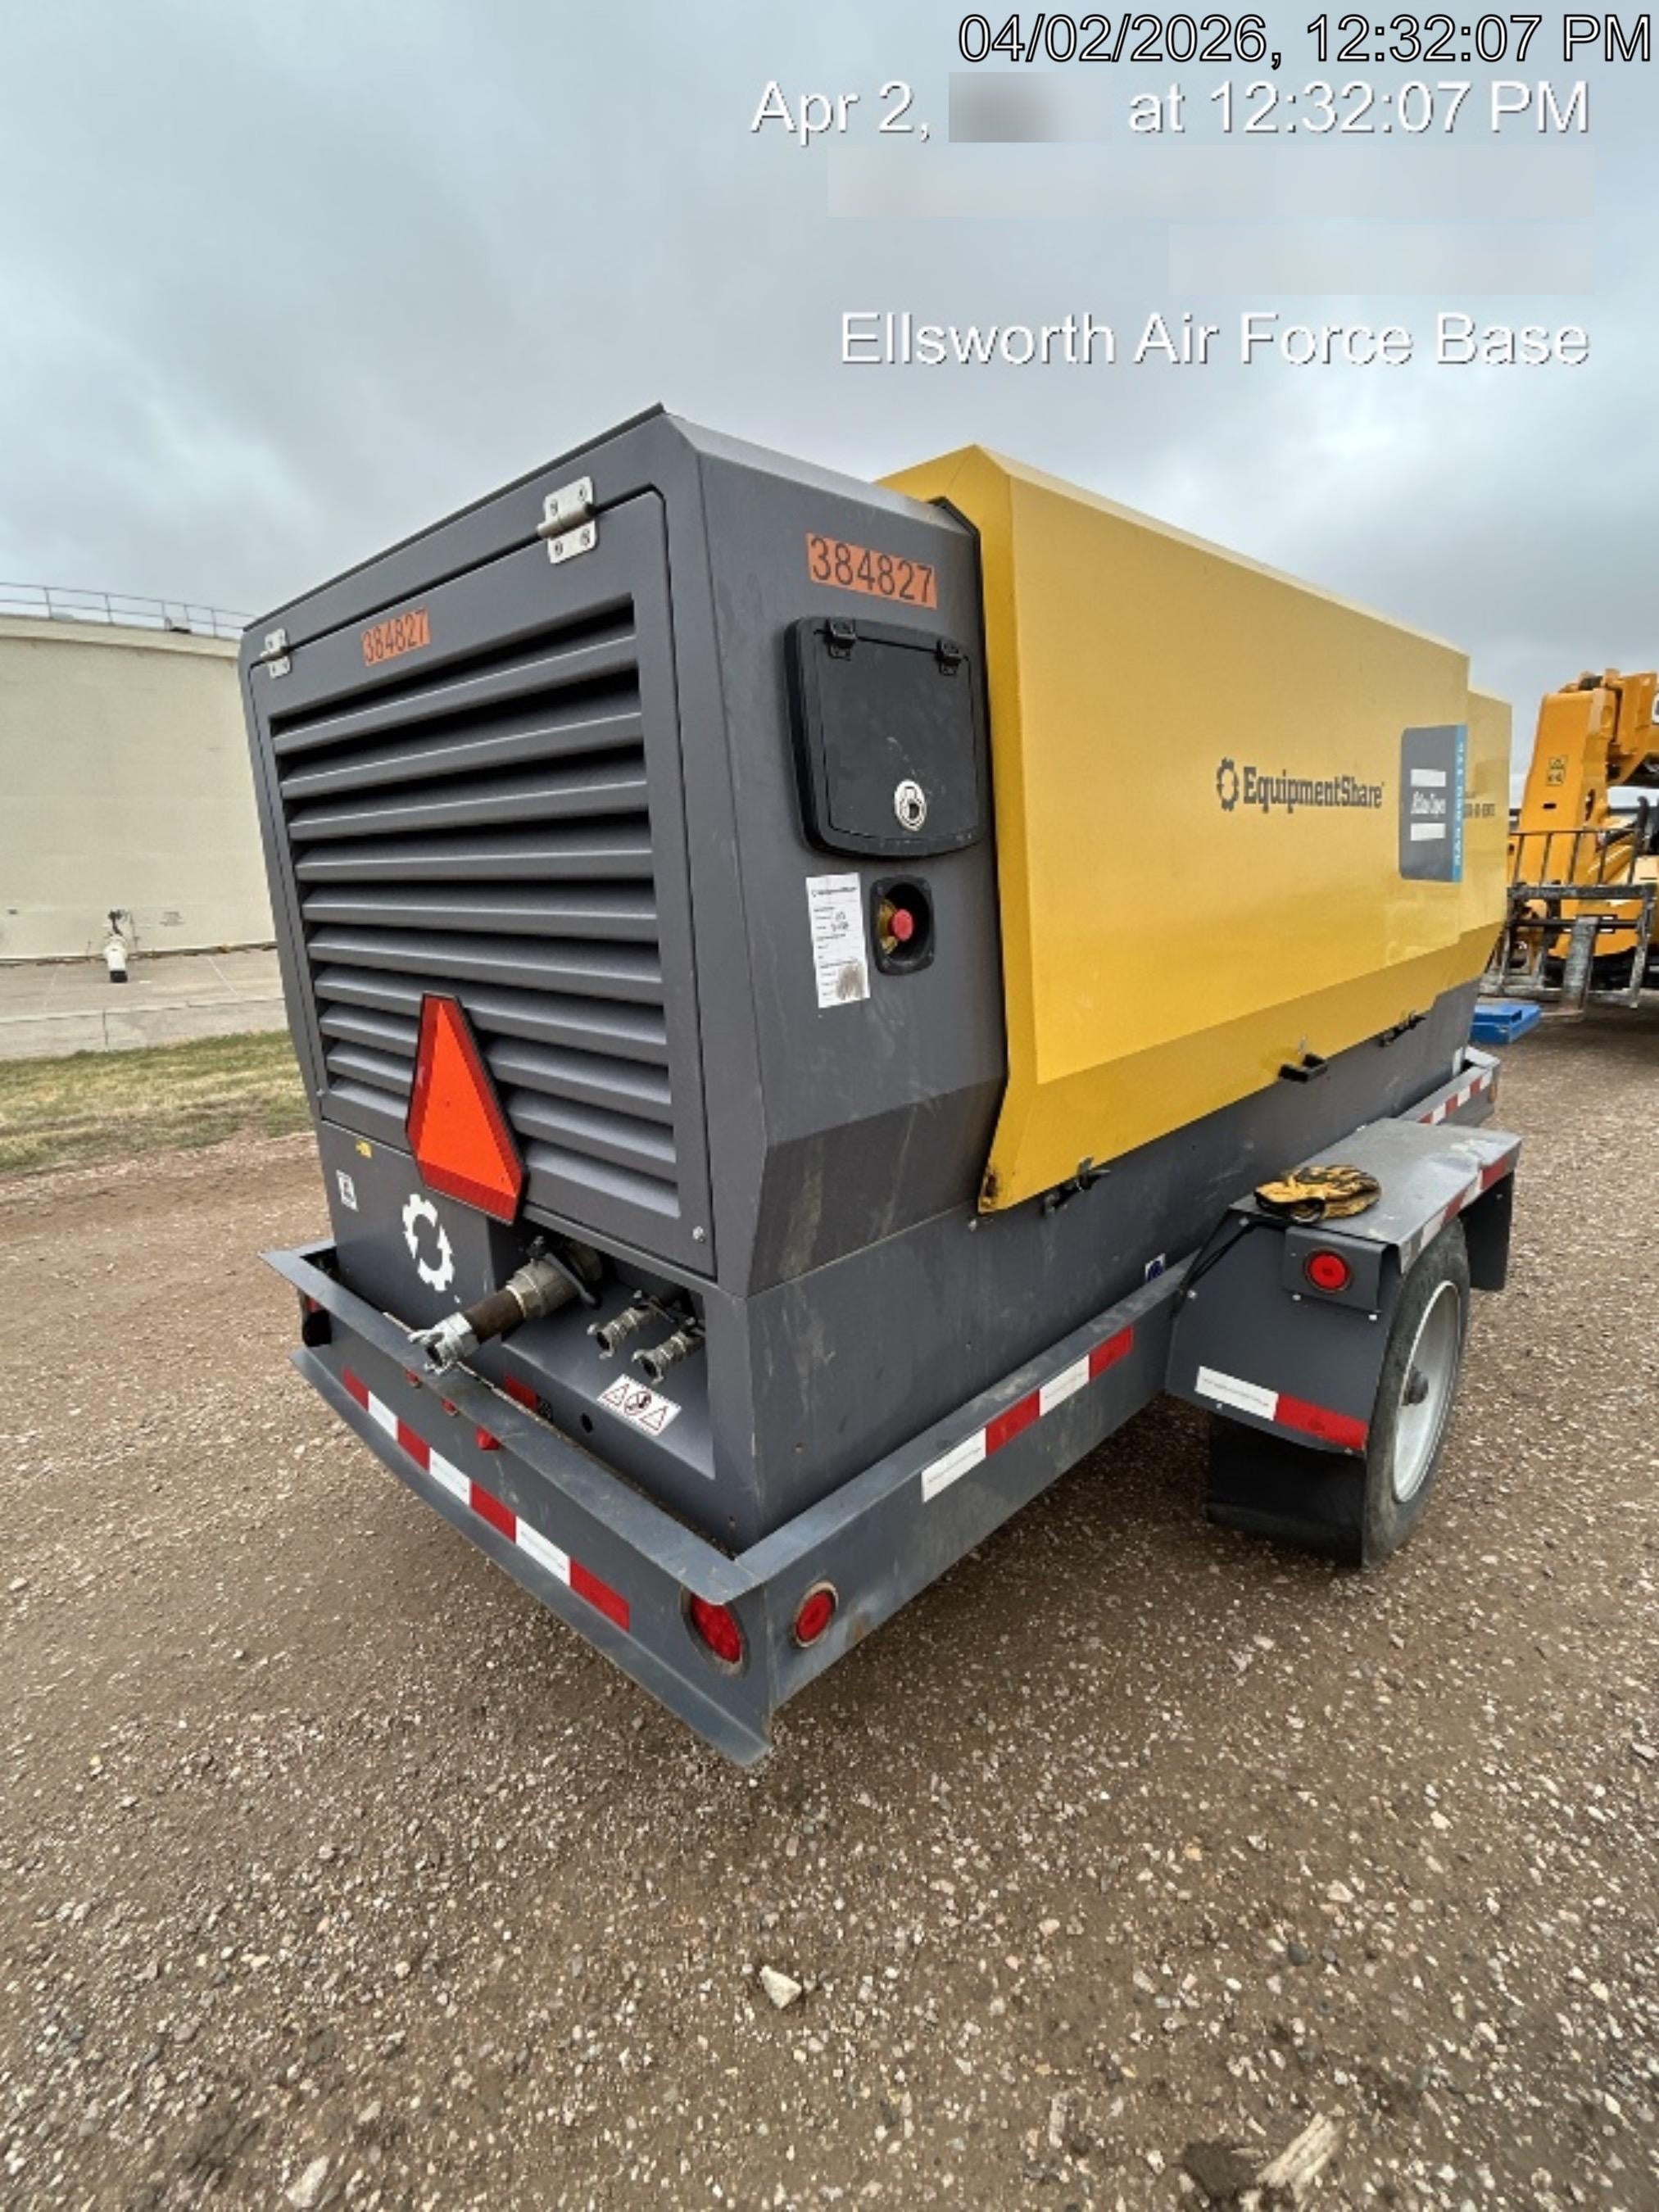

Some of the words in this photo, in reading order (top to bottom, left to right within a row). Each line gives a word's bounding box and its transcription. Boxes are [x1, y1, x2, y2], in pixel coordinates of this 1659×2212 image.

[809, 537, 934, 604] 384827
[365, 608, 426, 663] 384827
[1243, 766, 1382, 814] EquipmentShare
